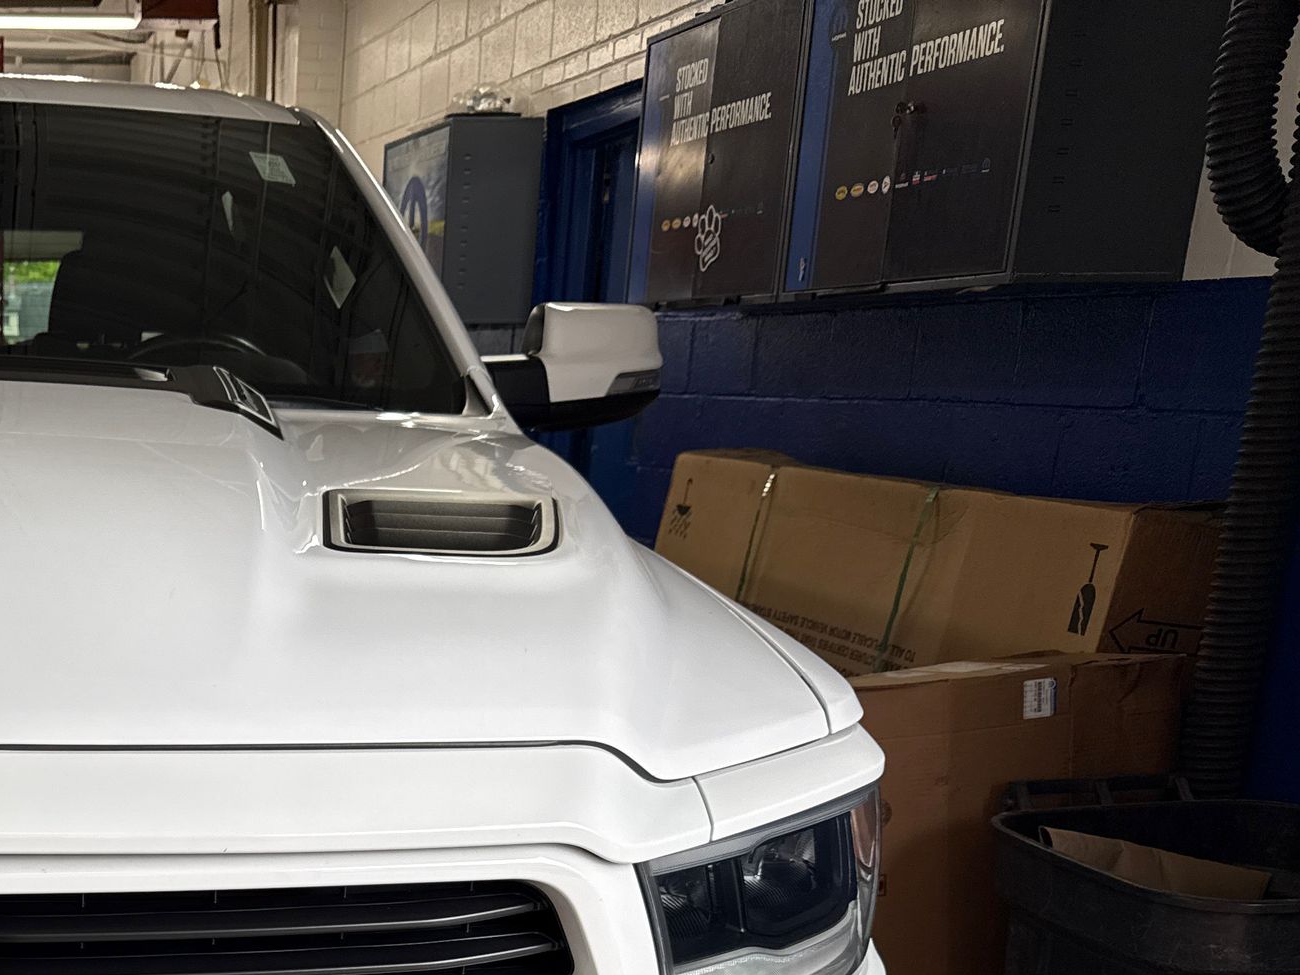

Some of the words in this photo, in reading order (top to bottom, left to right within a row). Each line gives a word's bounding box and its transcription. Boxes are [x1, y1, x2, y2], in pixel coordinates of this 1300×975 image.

[856, 0, 903, 29] STOCKED
[848, 50, 907, 96] AUTHENTIC
[909, 19, 1005, 77] PERFORMANCE.
[853, 25, 881, 63] WITH
[675, 57, 709, 93] STOCKED
[670, 112, 710, 147] AUTHENTIC
[710, 92, 772, 134] PERFORMANCE.
[673, 91, 693, 120] WITH
[1146, 628, 1178, 649] UP
